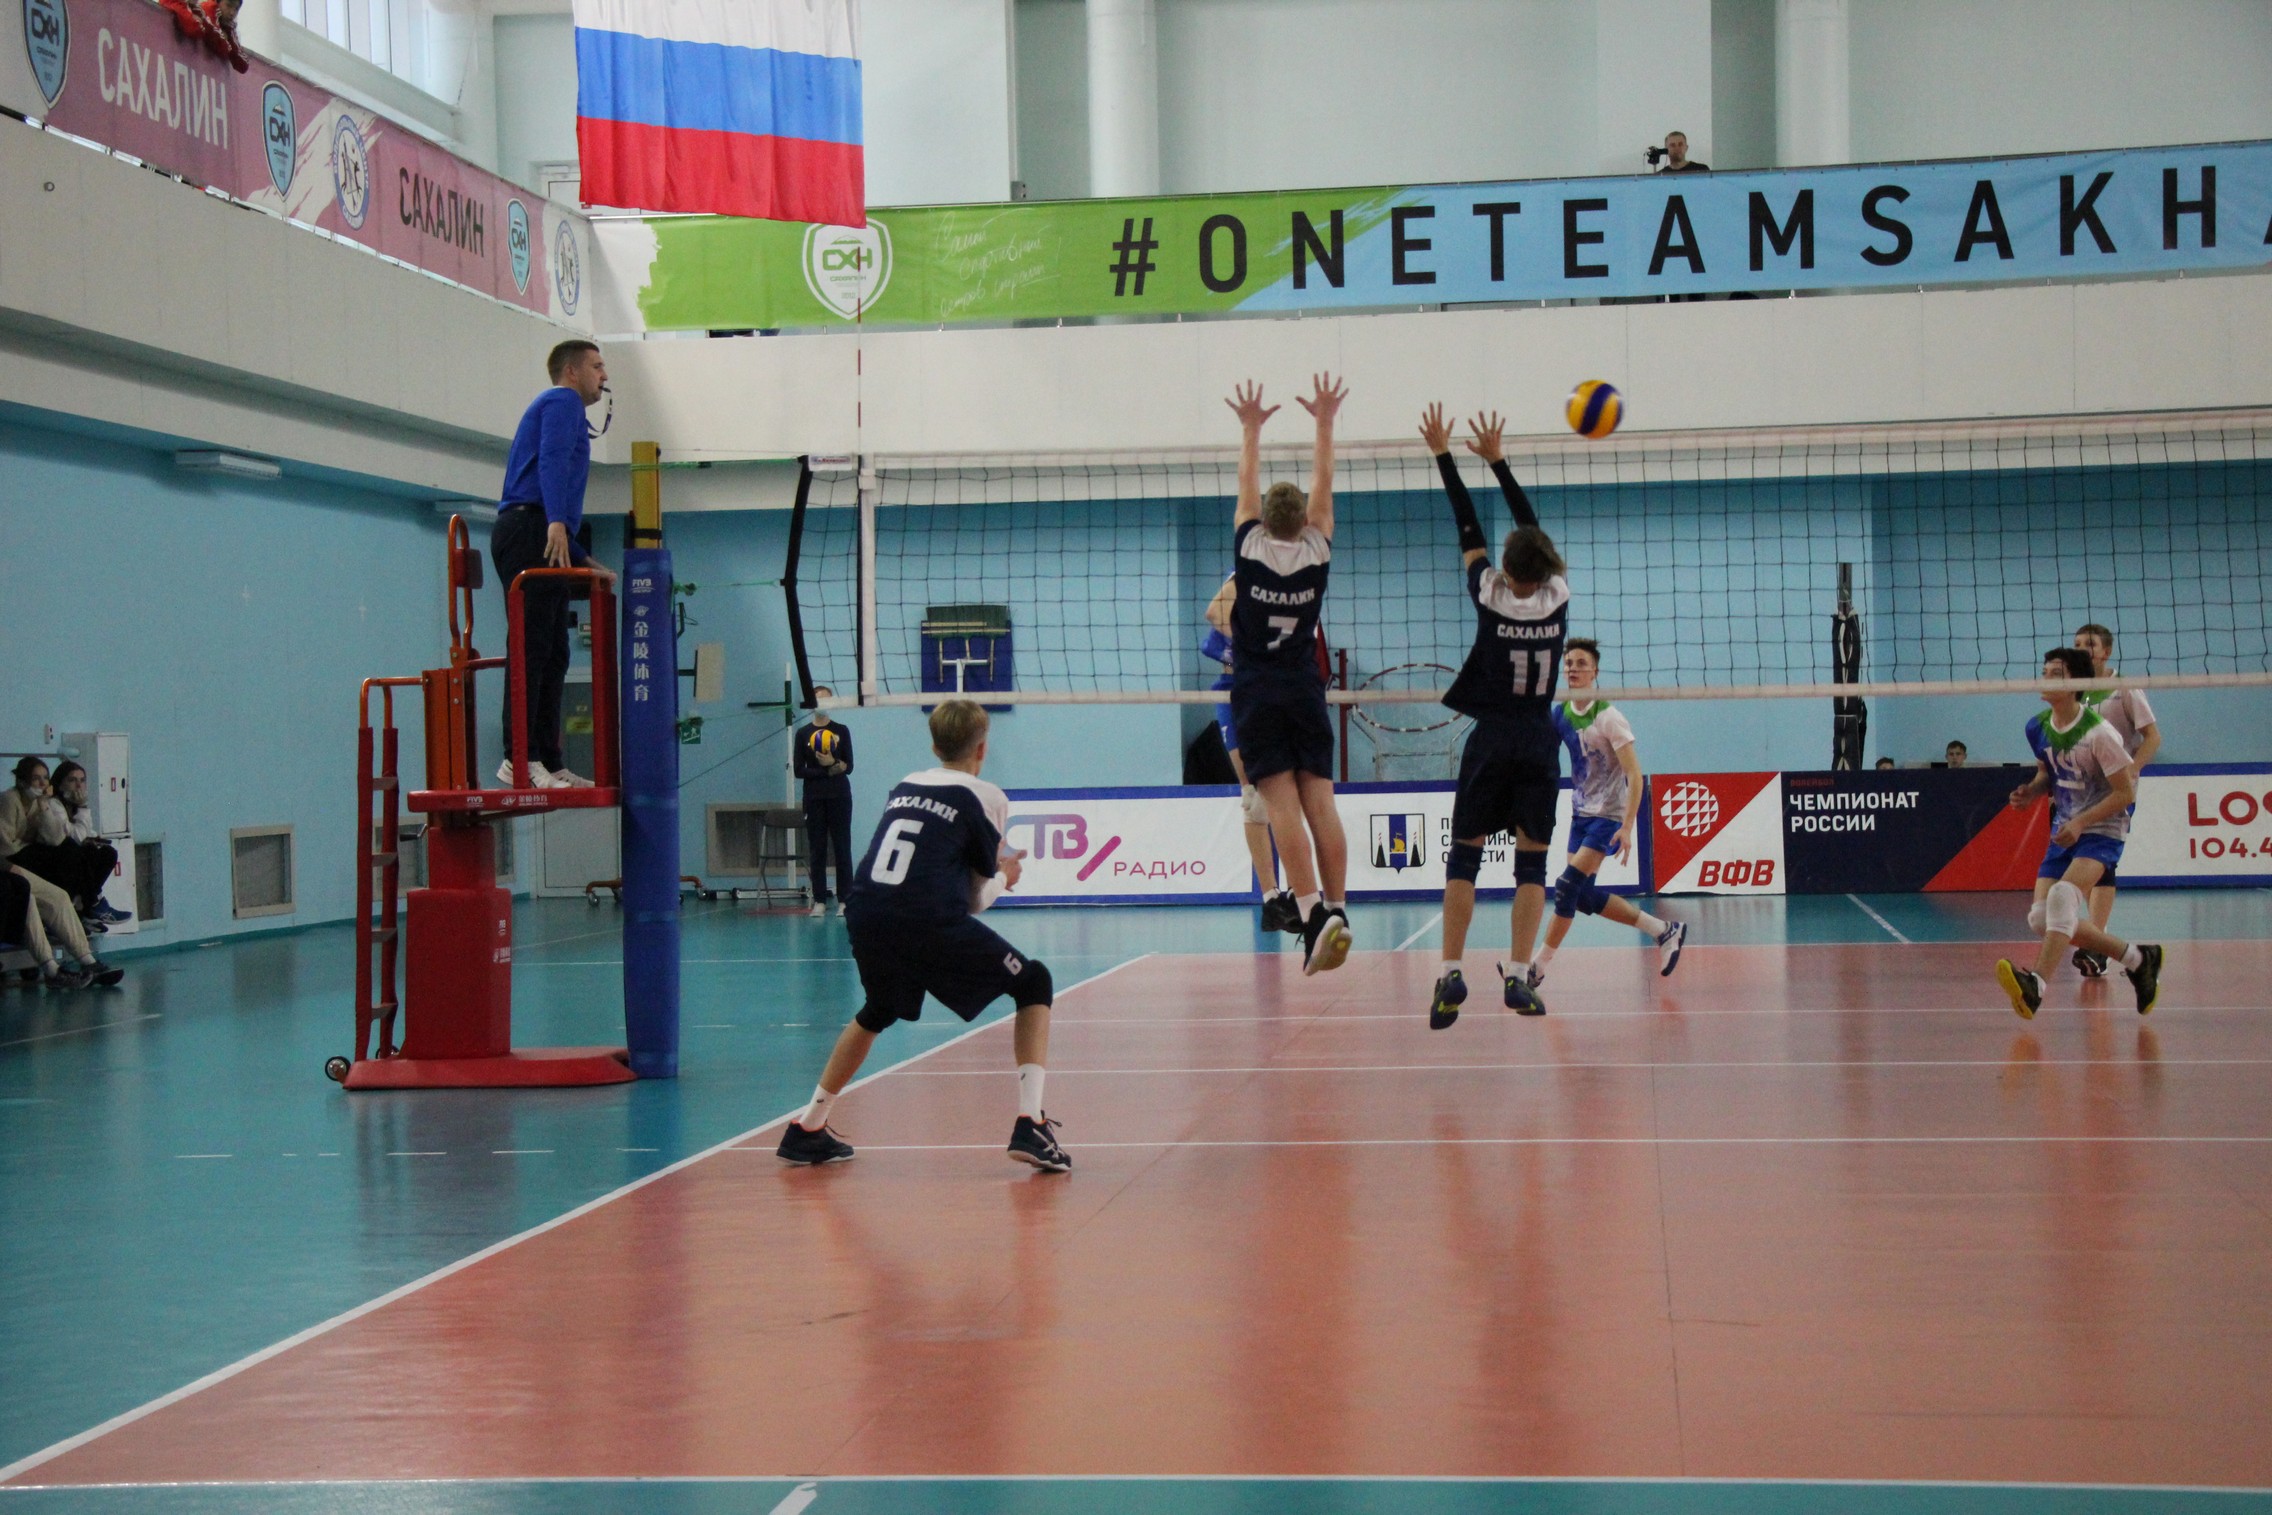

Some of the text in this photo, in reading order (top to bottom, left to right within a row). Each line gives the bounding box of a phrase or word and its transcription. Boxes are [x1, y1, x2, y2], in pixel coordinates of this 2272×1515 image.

[98, 27, 229, 150] САХАЛИН
[400, 167, 484, 258] САХАЛИН
[1109, 165, 2272, 297] #ONETEAMSAKH
[632, 578, 652, 587] FIVB
[1250, 585, 1315, 605] САХАЛИН
[1267, 615, 1299, 650] 7
[1497, 623, 1560, 639] САХАЛИН
[633, 621, 650, 702] 金陵体育
[1509, 648, 1552, 696] 11
[1789, 791, 1920, 812] ЧЕМПИОНАТ
[1791, 814, 1876, 833] РОССИИ
[870, 818, 925, 886] 6
[1114, 860, 1207, 880] РАДИО
[1698, 859, 1775, 887] ВФВ
[1003, 952, 1023, 976] 6
